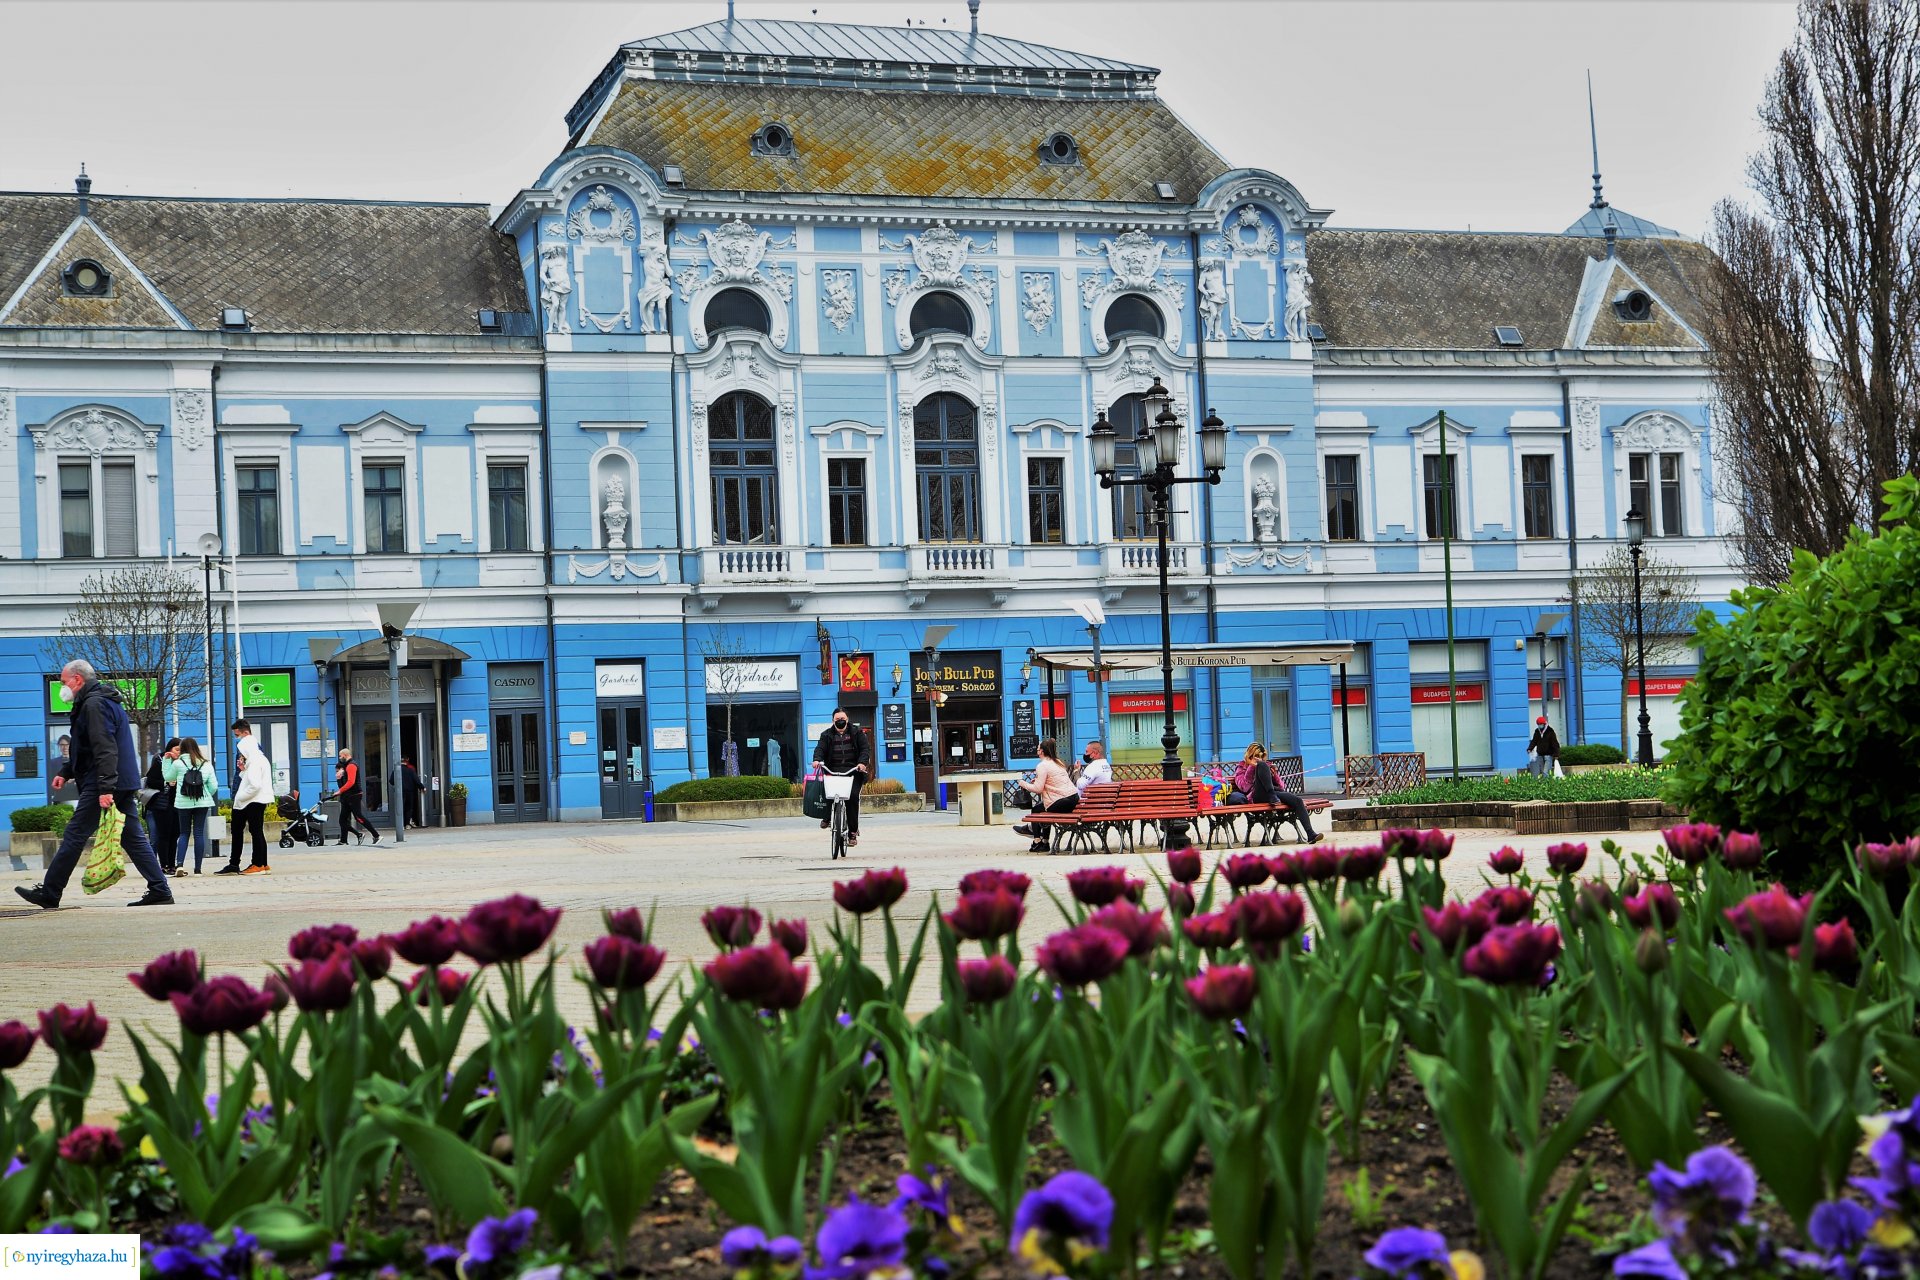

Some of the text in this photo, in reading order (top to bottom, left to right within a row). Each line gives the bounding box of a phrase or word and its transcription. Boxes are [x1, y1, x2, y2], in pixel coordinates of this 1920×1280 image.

[1177, 657, 1197, 666] BULL
[1197, 656, 1229, 665] KORONA
[1230, 656, 1246, 665] PUB
[845, 660, 864, 679] X
[915, 666, 995, 681] JON BULL PUB
[355, 674, 425, 690] KORNA
[494, 677, 535, 687] CASINO
[845, 679, 866, 688] CAFÉ
